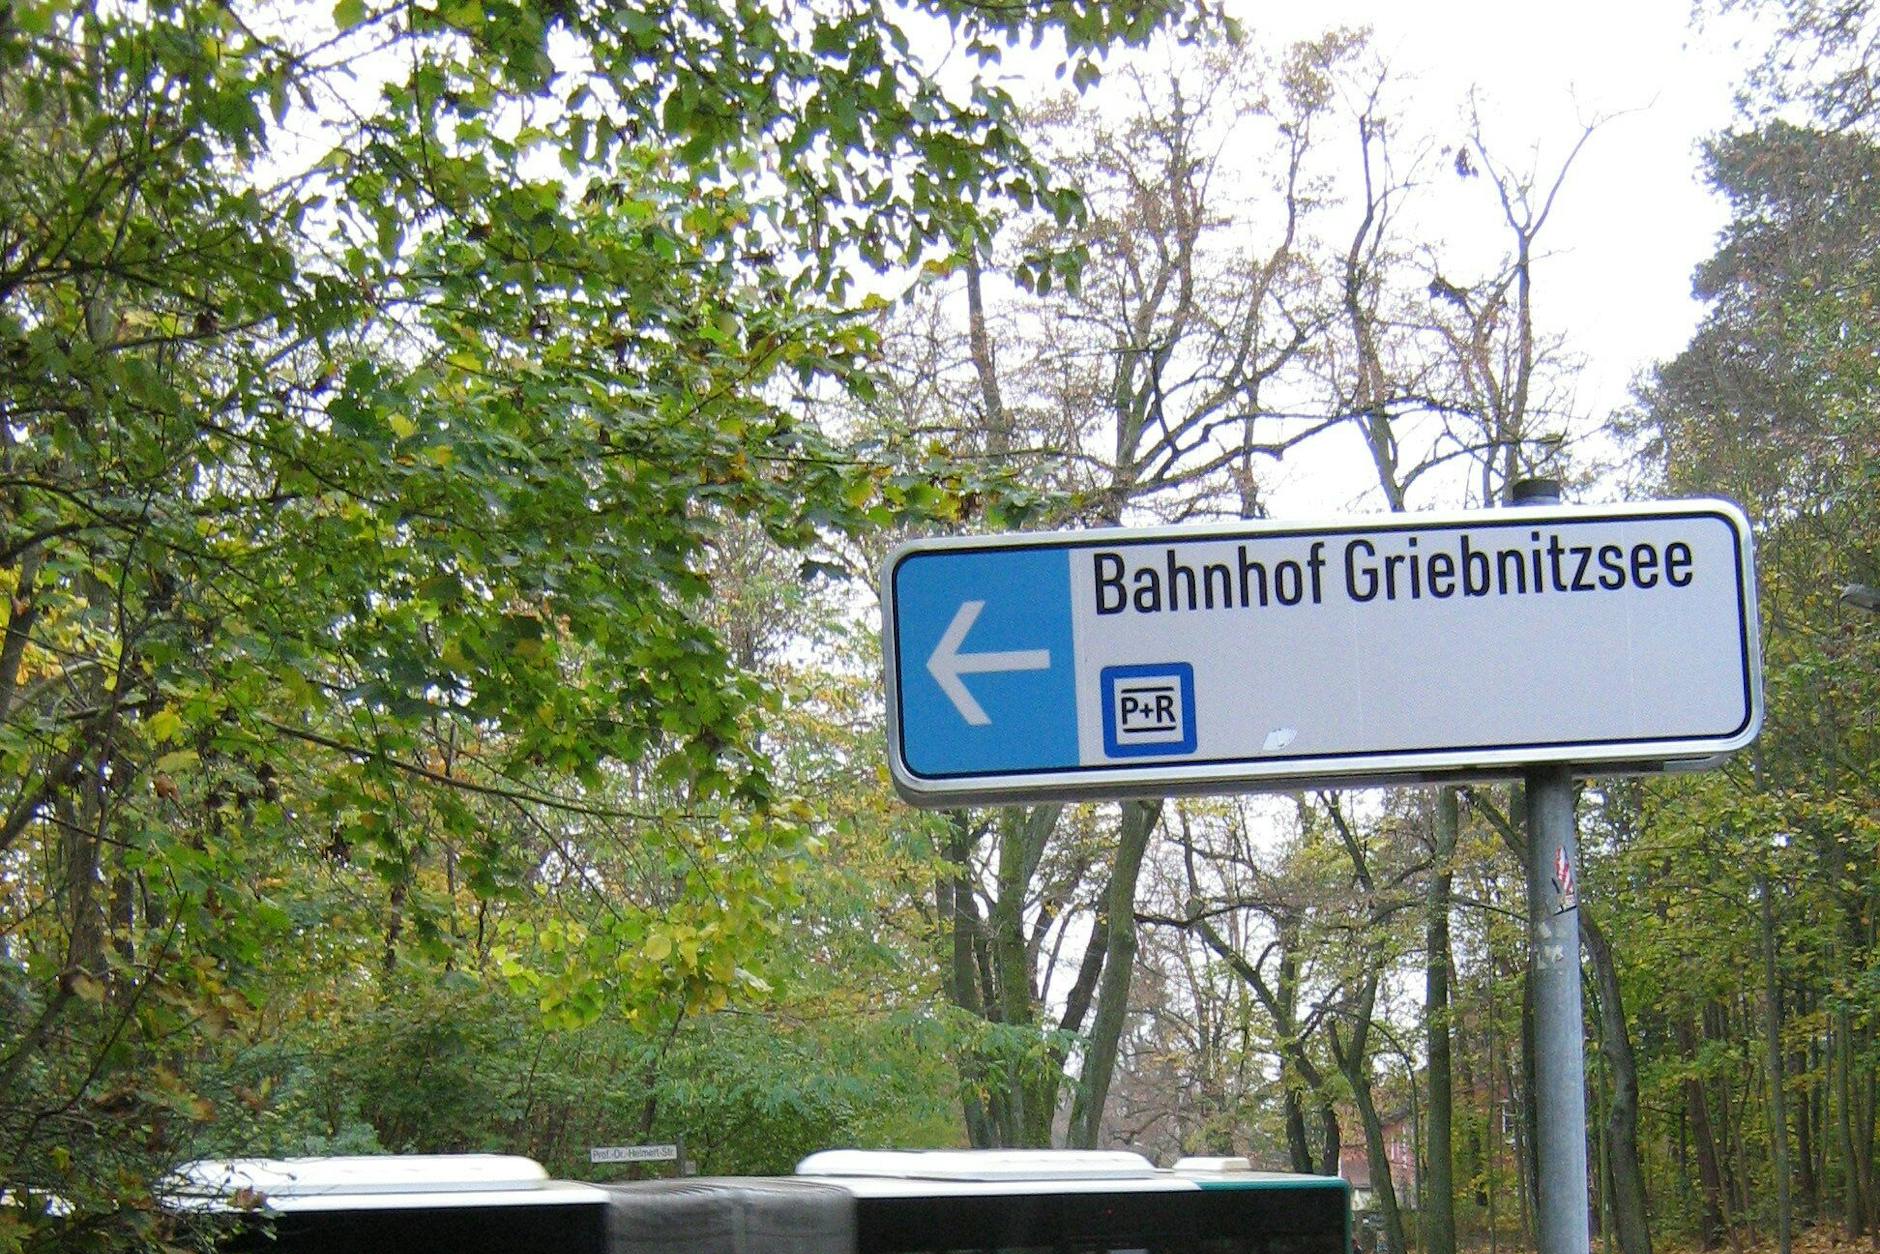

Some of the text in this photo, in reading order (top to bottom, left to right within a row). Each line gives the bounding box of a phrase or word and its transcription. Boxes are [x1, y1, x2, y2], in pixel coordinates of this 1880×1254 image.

[1093, 530, 1694, 616] Bahnhof Griebnitzsee
[1120, 694, 1177, 726] P+R
